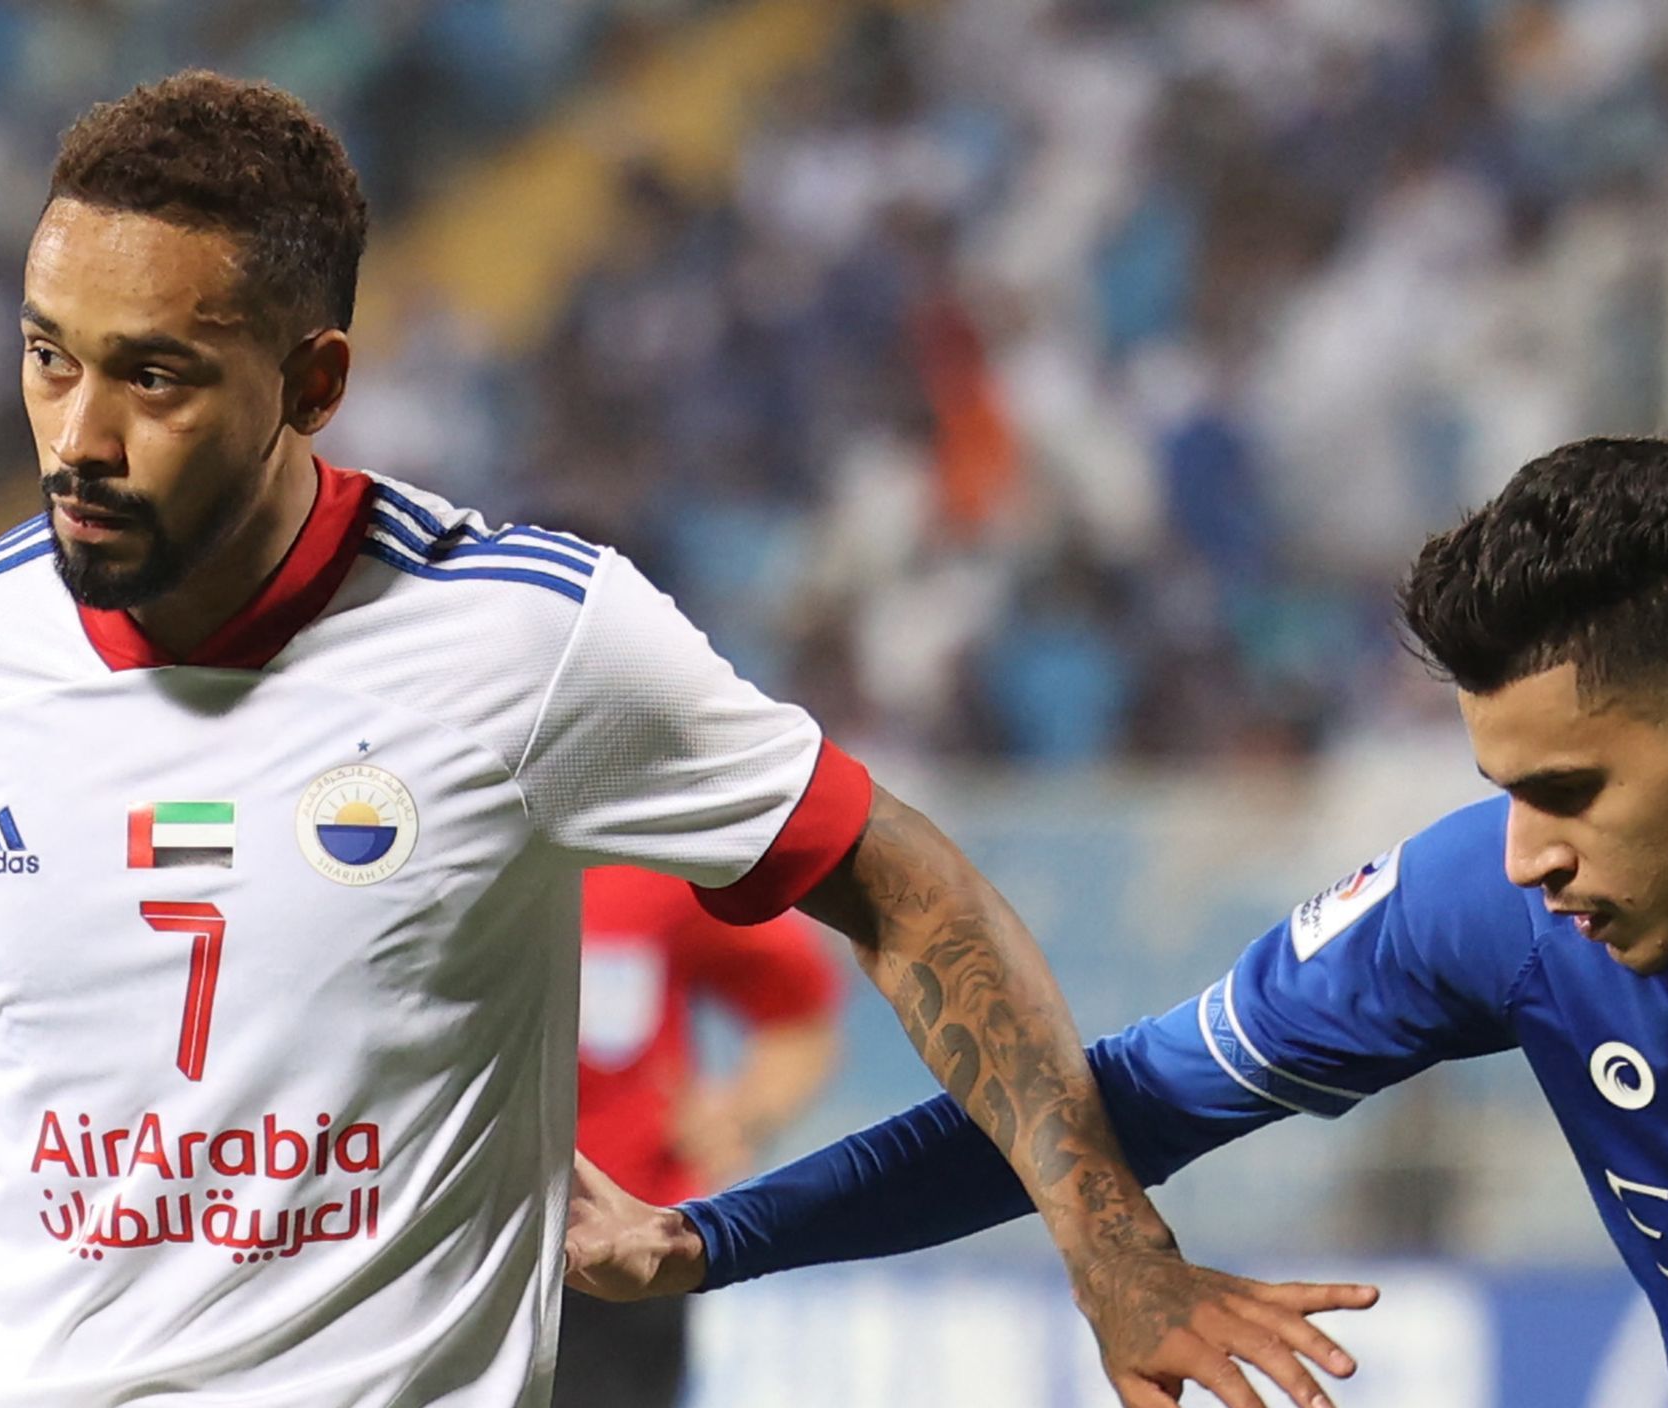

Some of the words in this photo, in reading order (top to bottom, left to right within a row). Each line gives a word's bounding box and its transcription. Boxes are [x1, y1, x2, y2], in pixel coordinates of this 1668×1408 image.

[316, 857, 376, 883] SHARJAH
[378, 859, 396, 876] FC
[139, 901, 227, 1082] 7
[31, 1109, 381, 1181] AirArabia
[200, 1184, 381, 1265] العربية
